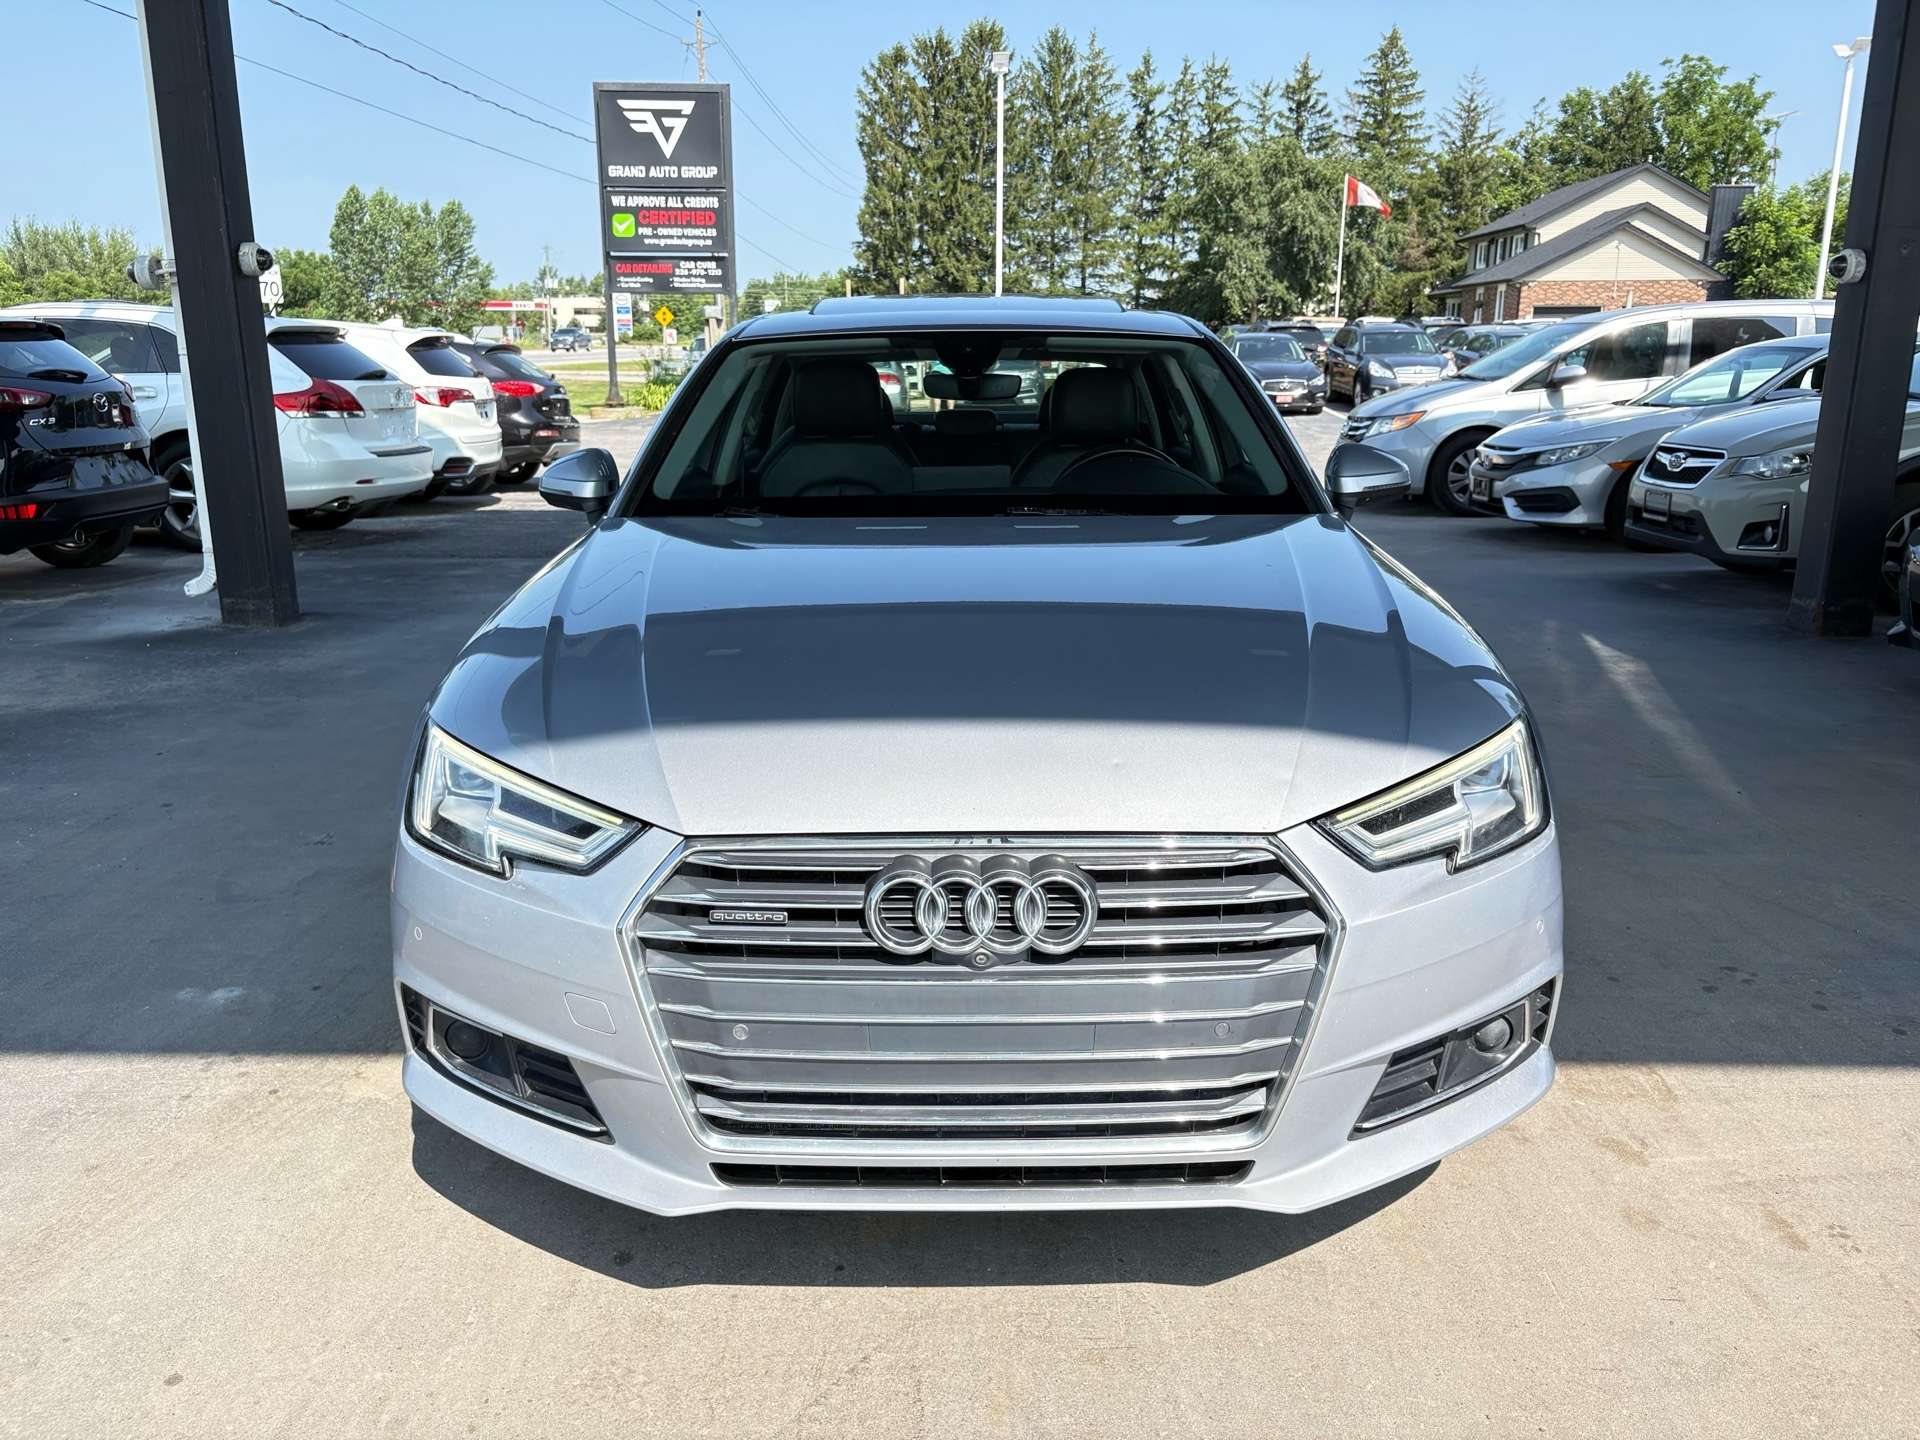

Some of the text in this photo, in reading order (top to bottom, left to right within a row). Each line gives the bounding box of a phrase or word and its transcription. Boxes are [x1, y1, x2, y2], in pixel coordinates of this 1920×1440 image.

[608, 165, 718, 179] GRAND AUTO GROUP
[611, 195, 719, 209] WE APPROVE ALL CREDITS
[638, 210, 716, 226] CERTIFIED
[638, 227, 653, 236] PRE
[657, 227, 683, 237] OWNED
[684, 228, 717, 237] VEHICLES
[616, 264, 673, 273] CAR DETAILING
[680, 261, 696, 269] CAR
[259, 281, 279, 297] 70
[713, 912, 784, 920] quattro
